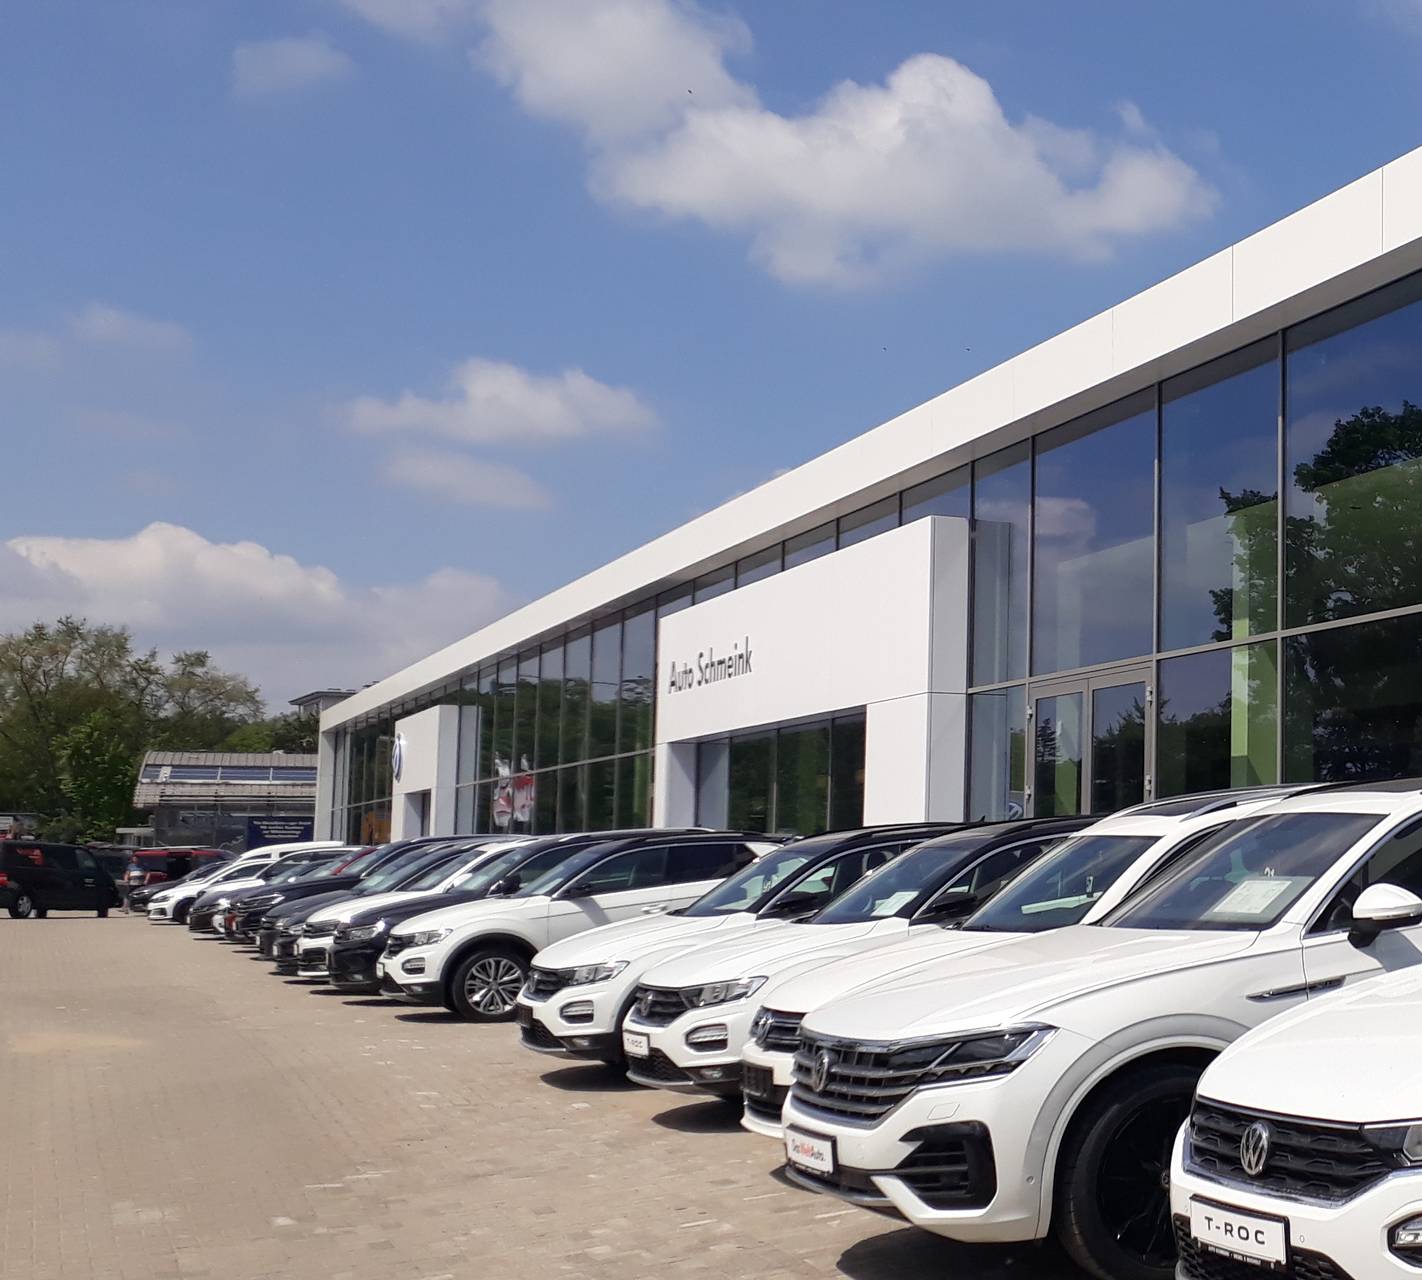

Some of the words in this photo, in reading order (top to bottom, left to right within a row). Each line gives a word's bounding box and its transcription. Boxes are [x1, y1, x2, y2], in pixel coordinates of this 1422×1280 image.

[668, 661, 694, 694] Auto
[697, 636, 752, 686] Schmeink
[1204, 1216, 1265, 1245] T-ROC
